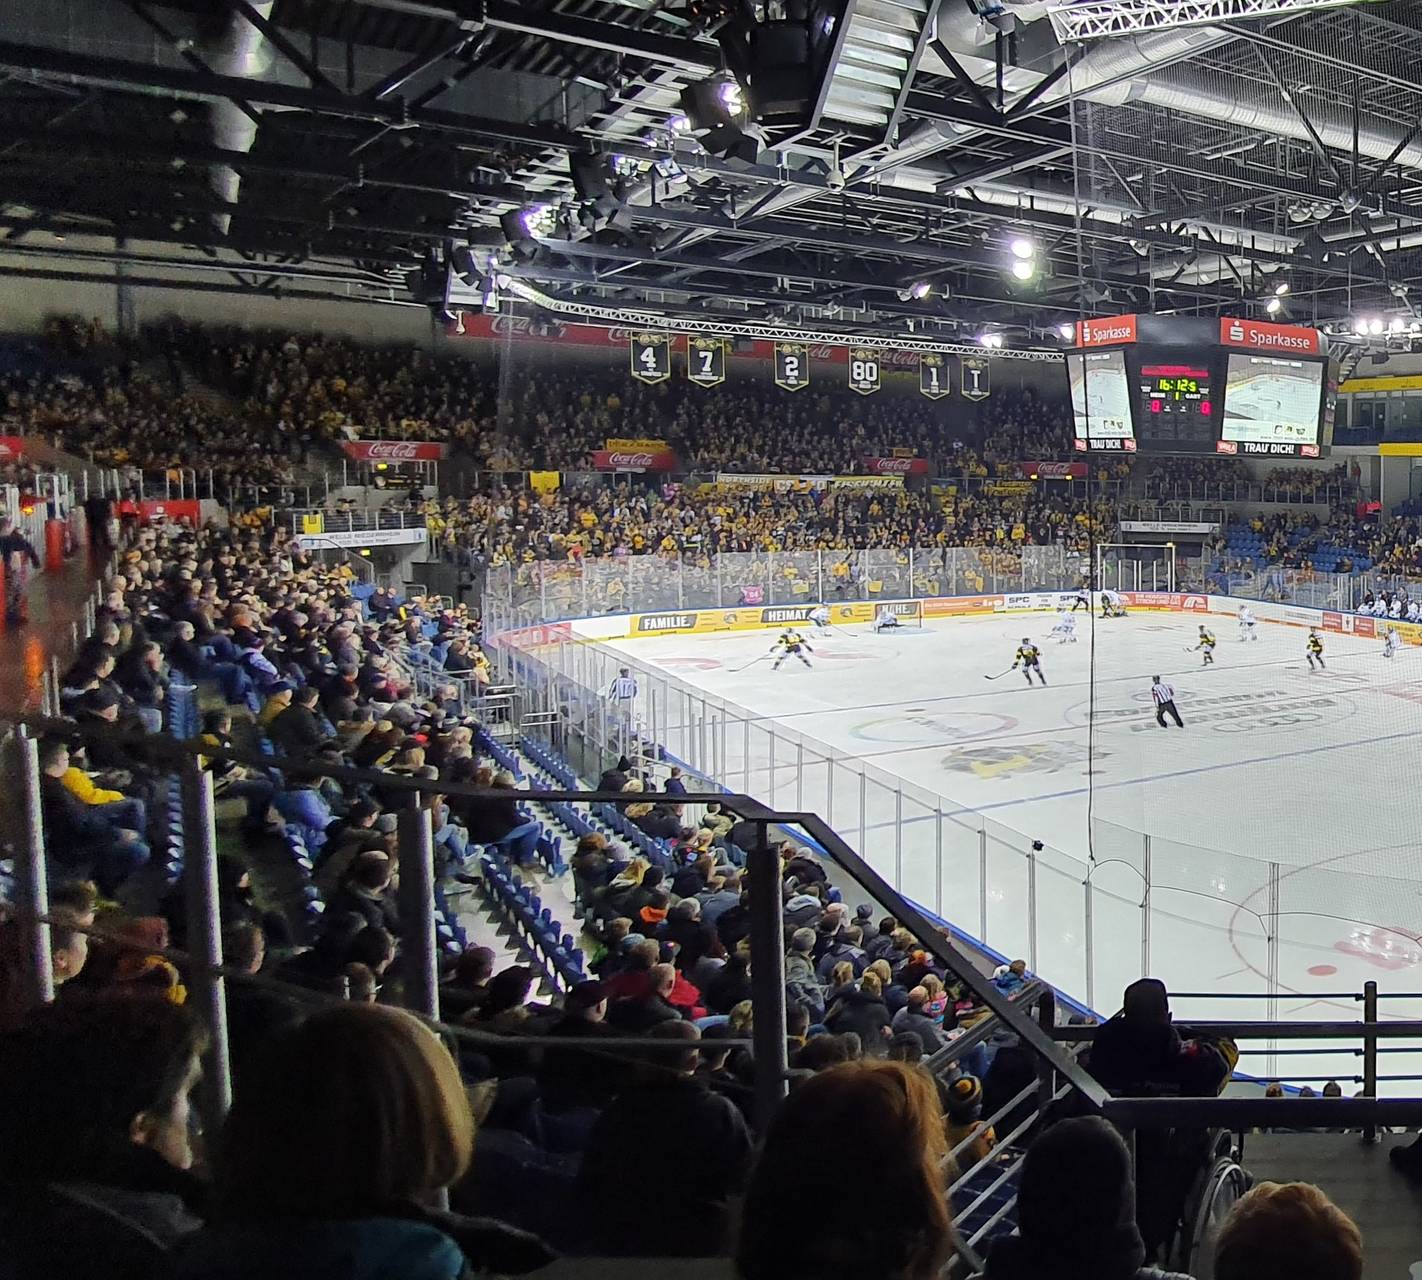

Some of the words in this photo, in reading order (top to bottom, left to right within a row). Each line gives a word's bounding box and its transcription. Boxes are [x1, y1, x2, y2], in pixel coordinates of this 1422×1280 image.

[1093, 326, 1131, 343] Sparkasse
[1249, 329, 1310, 349] Sparkasse
[640, 346, 657, 368] 4
[699, 351, 713, 372] 7
[784, 356, 799, 377] 2
[852, 361, 878, 381] 80
[1270, 444, 1295, 454] DICH!
[1009, 596, 1030, 604] SPC
